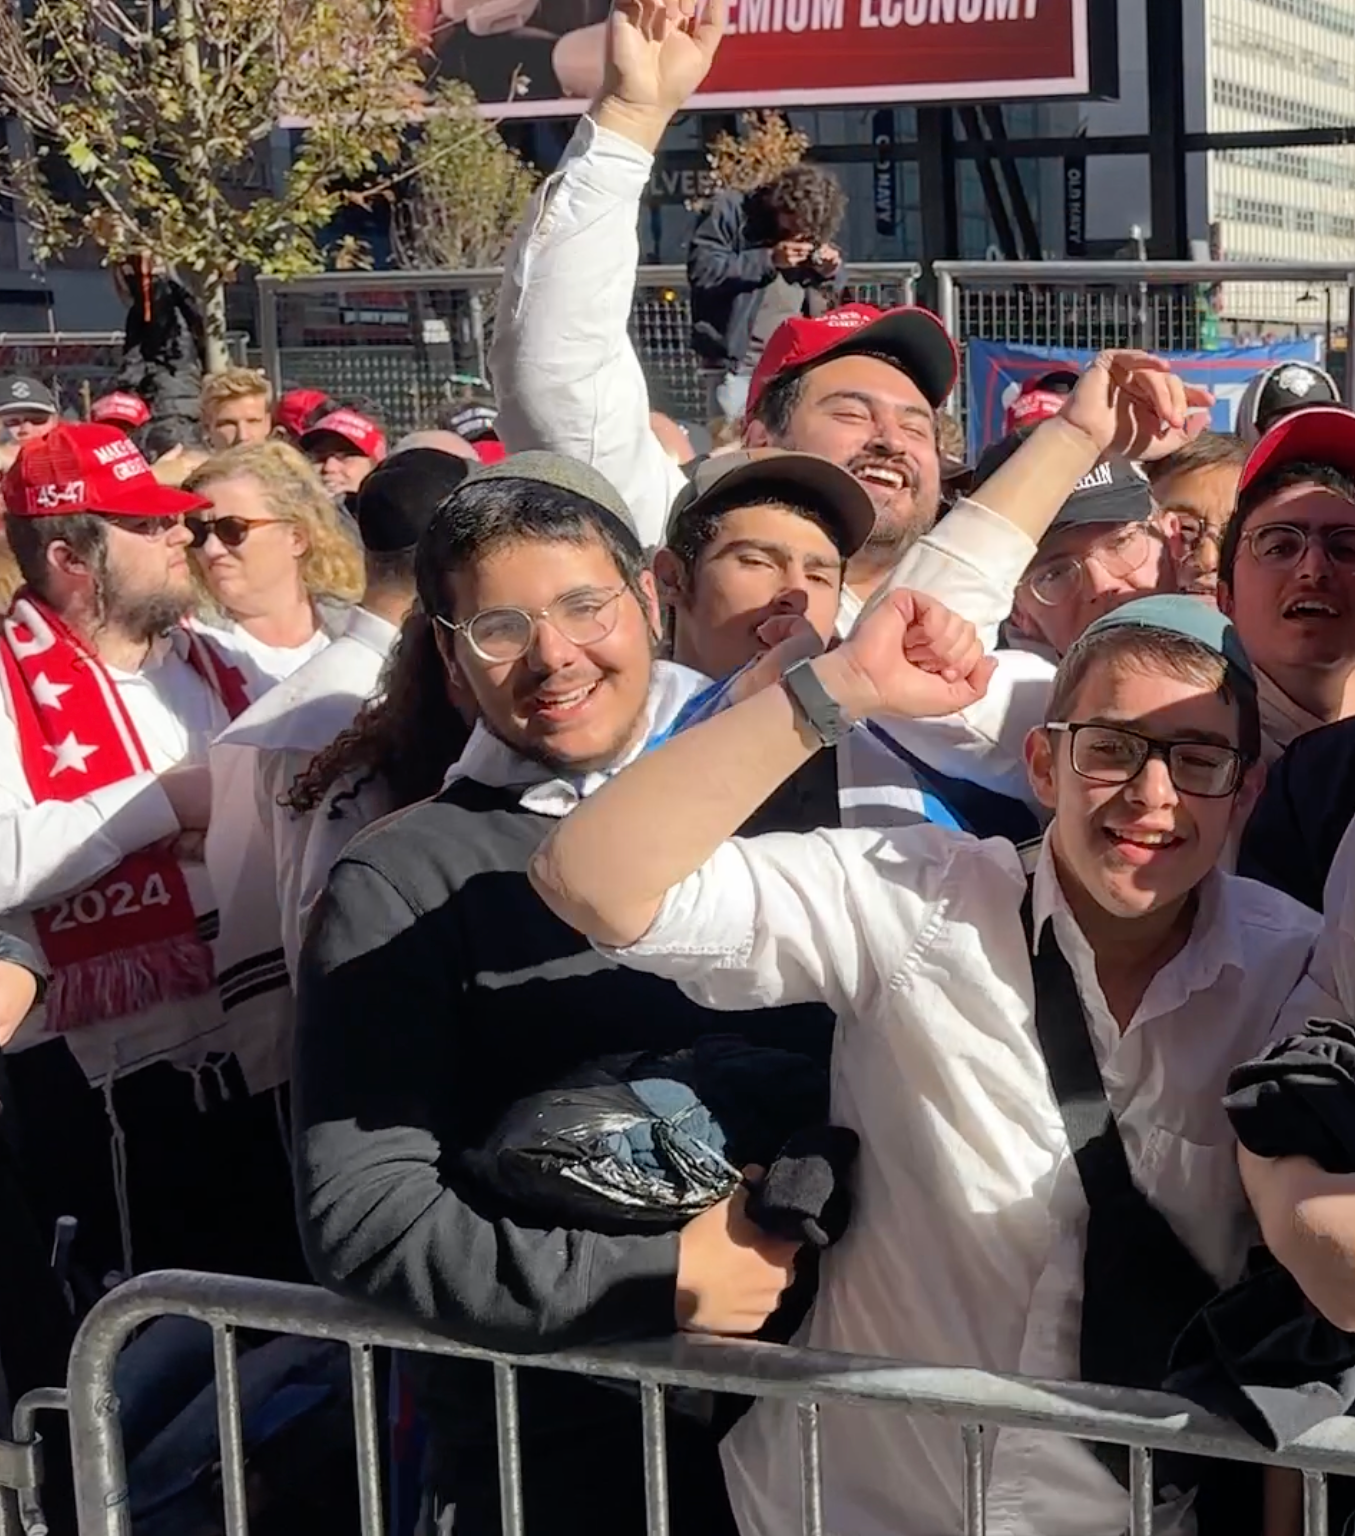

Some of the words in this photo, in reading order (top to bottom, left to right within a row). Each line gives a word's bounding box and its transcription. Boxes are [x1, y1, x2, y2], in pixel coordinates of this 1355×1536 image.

[720, 0, 843, 35] EMIUM
[1067, 168, 1081, 200] OLD
[37, 480, 85, 508] 45-47
[49, 872, 172, 933] 2024
